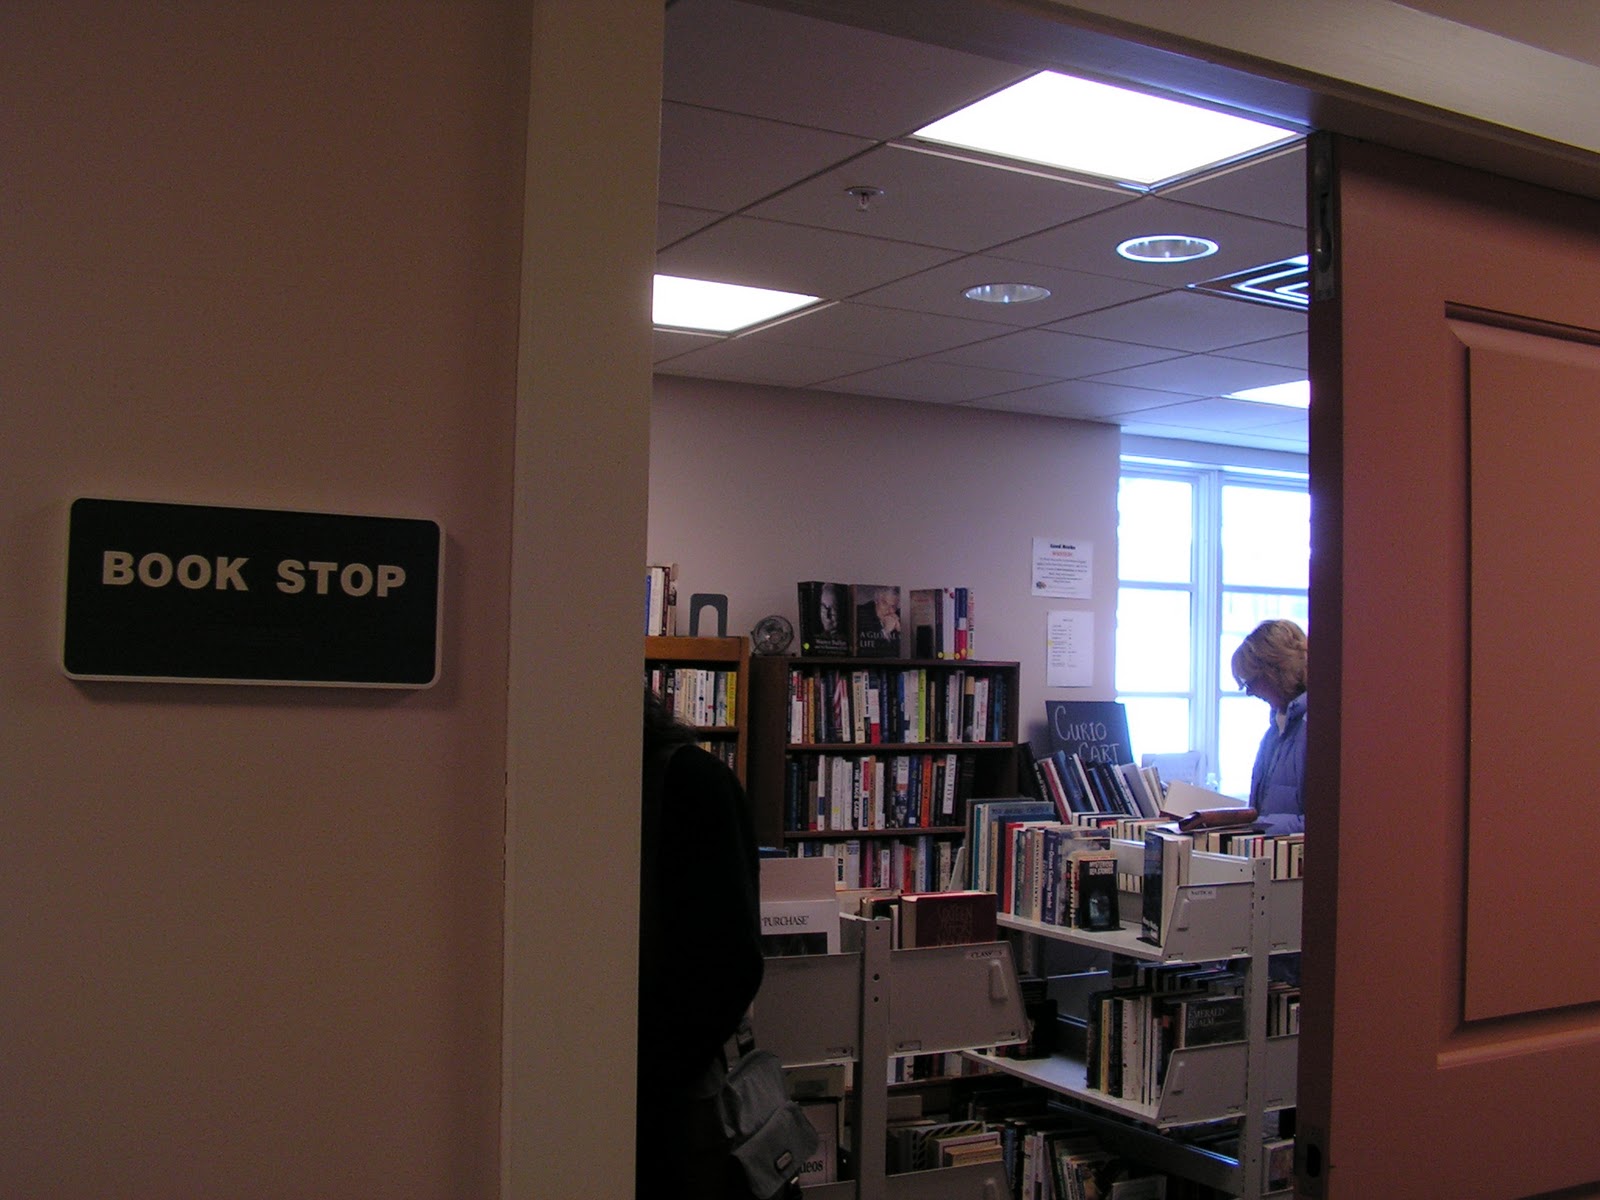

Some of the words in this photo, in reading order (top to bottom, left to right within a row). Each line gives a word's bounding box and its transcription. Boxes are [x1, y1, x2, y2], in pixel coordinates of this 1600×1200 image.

[102, 550, 249, 591] BOOK
[276, 558, 406, 597] STOP
[1078, 742, 1120, 764] CART
